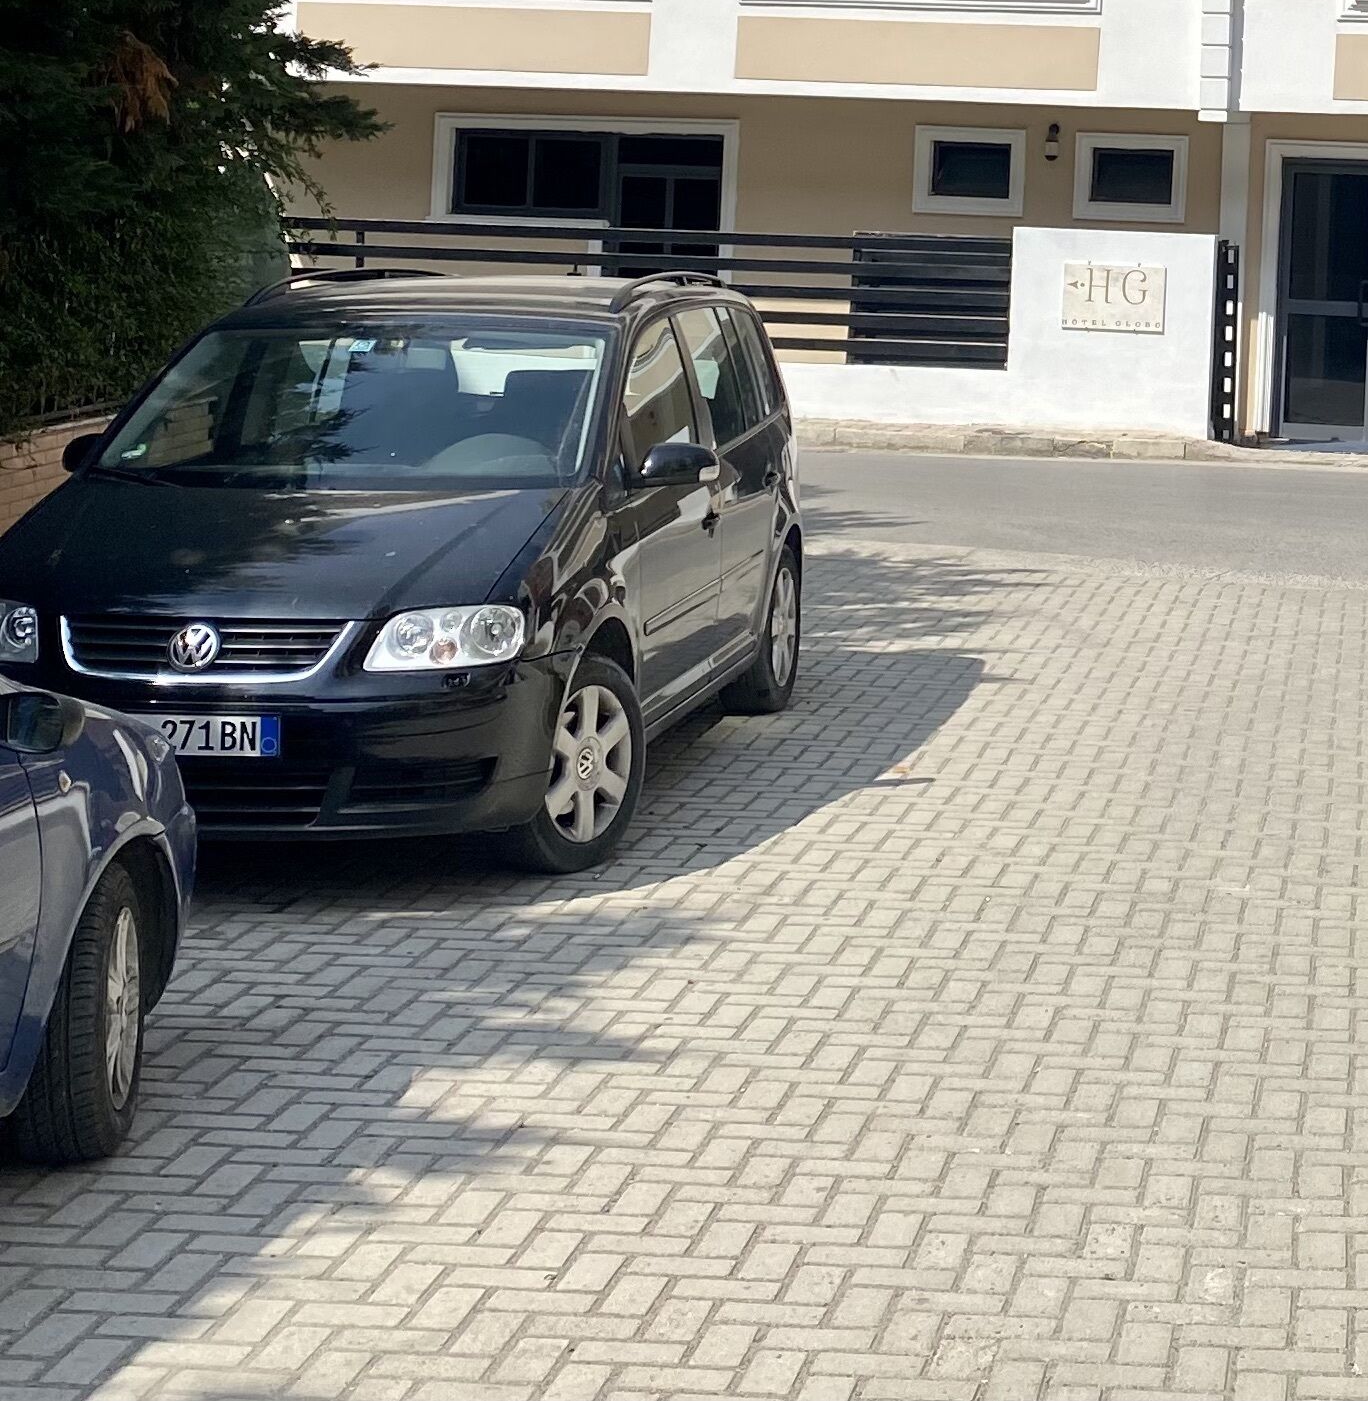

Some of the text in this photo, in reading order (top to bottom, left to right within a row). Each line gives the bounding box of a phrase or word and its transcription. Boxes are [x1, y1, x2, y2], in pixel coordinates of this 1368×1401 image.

[1061, 318, 1161, 329] HOTEL GLOBO
[161, 719, 257, 751] 271BN
